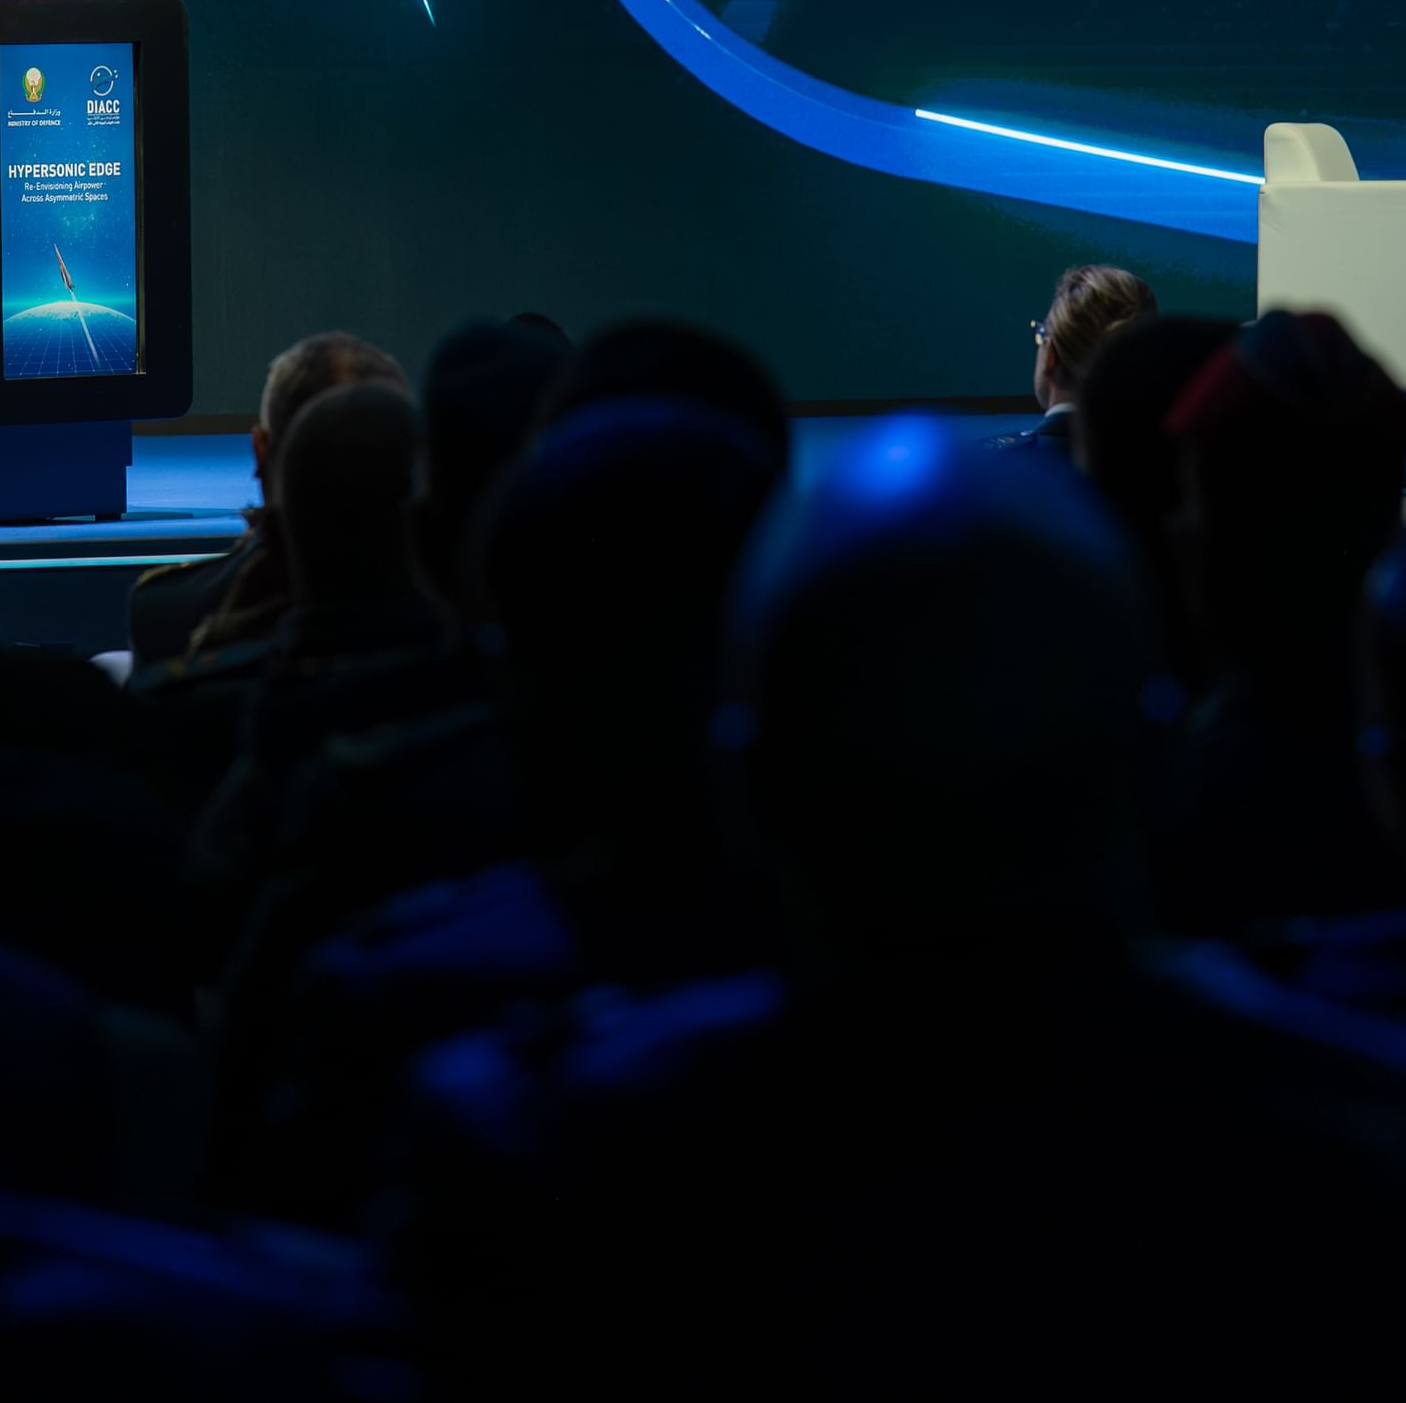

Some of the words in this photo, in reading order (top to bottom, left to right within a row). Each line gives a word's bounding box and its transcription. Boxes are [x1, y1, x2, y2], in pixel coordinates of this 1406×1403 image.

[87, 99, 120, 114] DIACC
[8, 163, 86, 179] HYPERSONIC
[89, 162, 121, 177] EDGE
[24, 181, 73, 192] Re-Envisioning
[74, 180, 104, 191] Airpower
[21, 194, 44, 203] Across
[85, 191, 109, 202] Spaces
